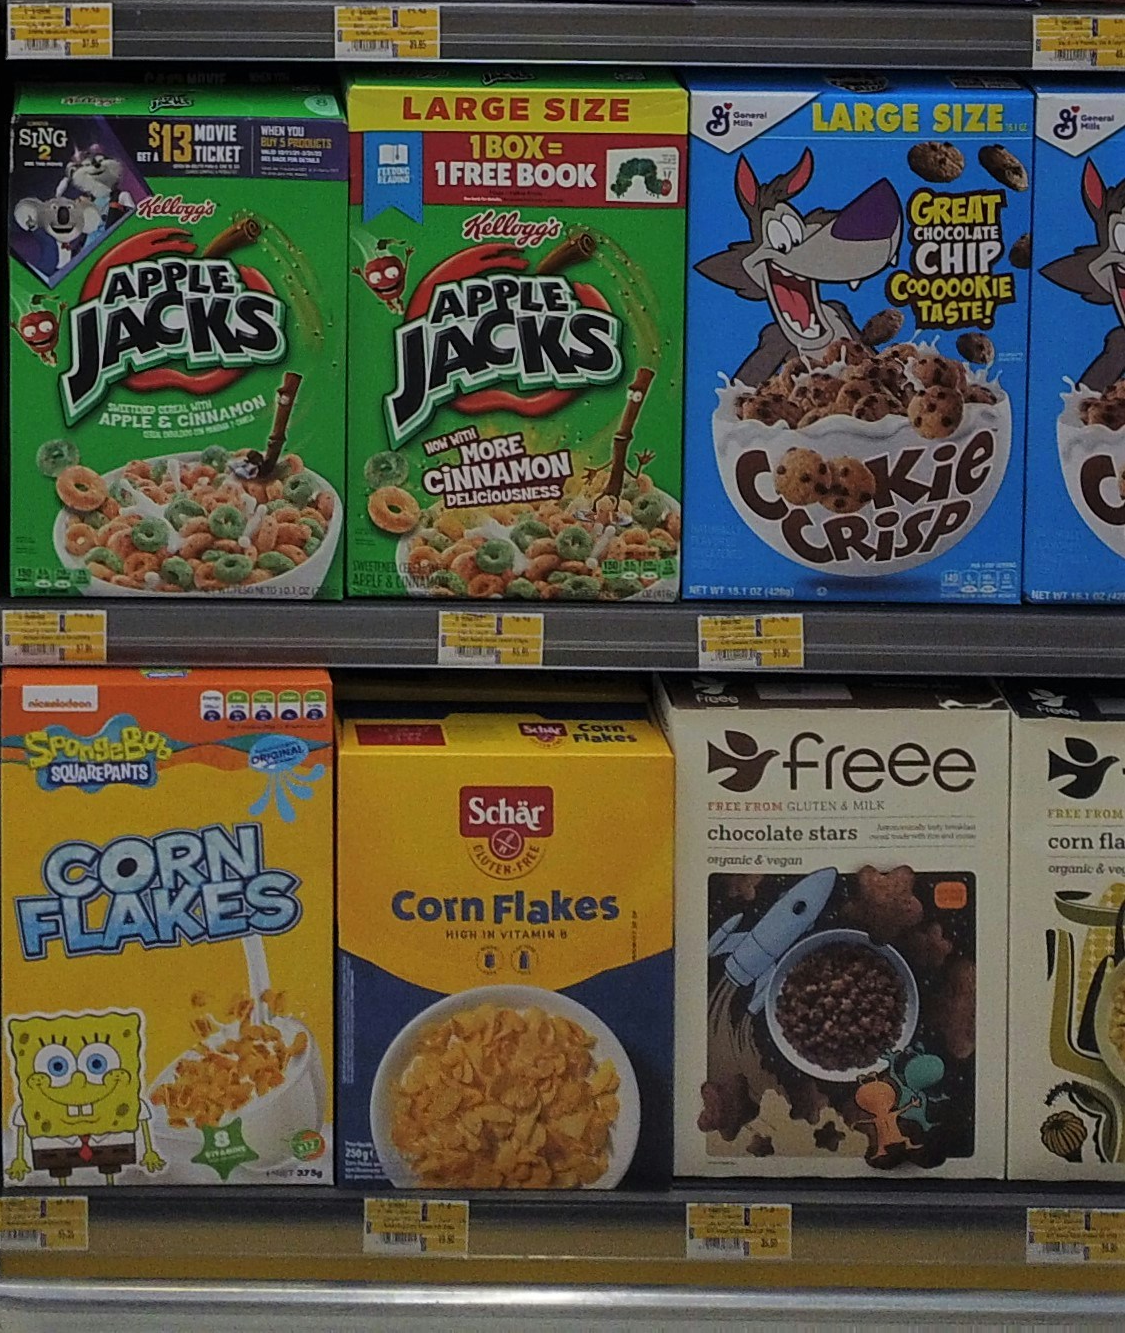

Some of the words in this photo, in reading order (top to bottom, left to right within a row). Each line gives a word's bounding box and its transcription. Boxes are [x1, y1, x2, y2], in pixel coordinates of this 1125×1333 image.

[194, 124, 237, 141] MOVIE
[481, 135, 542, 159] BOX
[195, 146, 241, 163] TICKET
[445, 163, 511, 185] FREE
[517, 162, 598, 188] BOOK
[911, 194, 1002, 226] GREAT
[914, 225, 999, 240] CHOCOLATE
[915, 243, 1001, 275] CHIP
[104, 260, 233, 302] APPLE
[71, 289, 283, 412] JACKS
[461, 435, 524, 464] MORE
[423, 450, 572, 494] CINNAMON
[446, 484, 561, 506] DELICIOUSNESS
[50, 763, 149, 784] SQUAREPANTS
[783, 732, 976, 793] freee
[468, 797, 545, 831] Schär
[707, 823, 803, 842] chocolate
[809, 825, 857, 842] stars
[44, 824, 263, 898] CORN
[17, 871, 303, 959] FLAKES
[392, 891, 484, 923] Corn
[493, 889, 620, 924] Flakes
